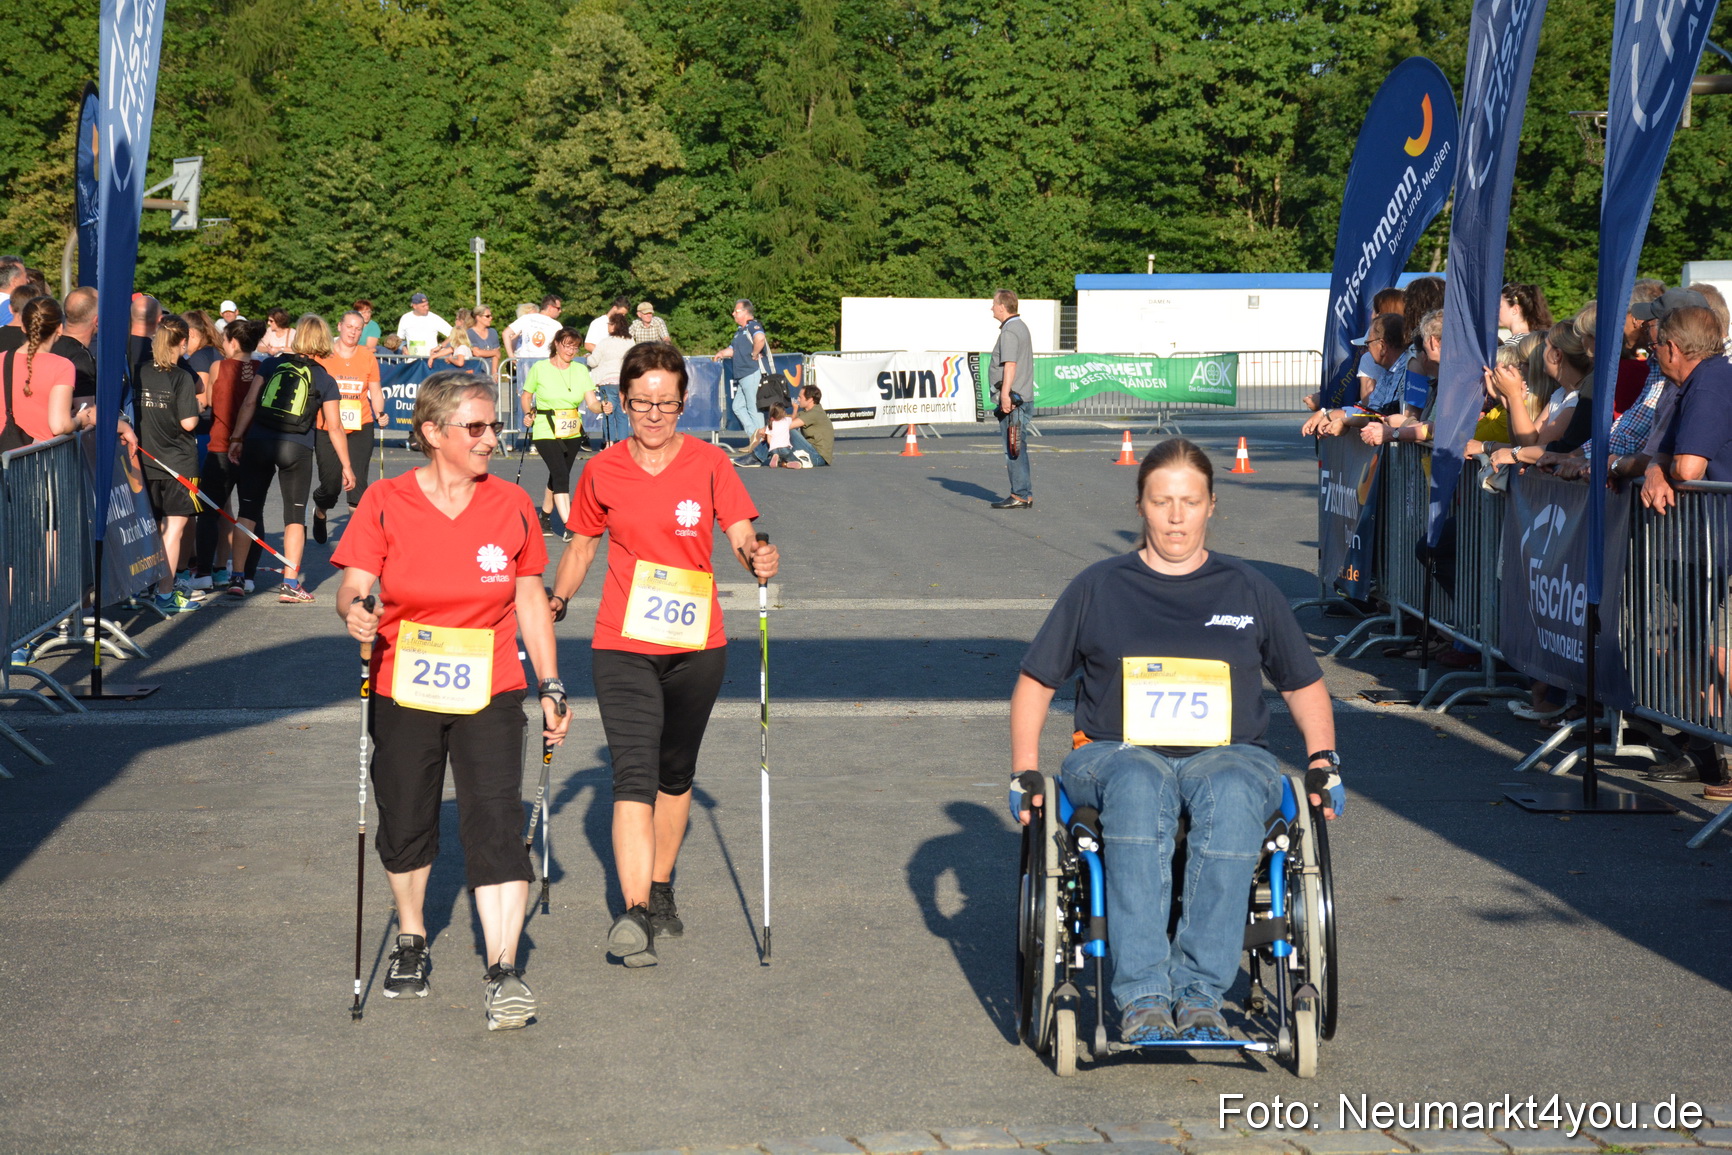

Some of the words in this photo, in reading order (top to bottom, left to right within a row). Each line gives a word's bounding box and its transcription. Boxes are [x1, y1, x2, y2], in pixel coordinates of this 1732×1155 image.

[1388, 214, 1408, 255] Druck
[1407, 189, 1422, 217] und
[1421, 140, 1451, 191] Medien
[1335, 165, 1417, 329] Frischmann
[1054, 362, 1153, 379] GESUNDHEIT
[1189, 360, 1232, 387] AOK
[877, 370, 937, 400] swn
[920, 401, 957, 413] neumarkt
[561, 420, 577, 430] 248
[675, 529, 698, 537] caritas
[480, 574, 510, 583] caritas
[643, 596, 697, 626] 266
[1537, 627, 1584, 664] AUTOMOBILE
[412, 658, 471, 690] 258
[1146, 691, 1209, 719] 775
